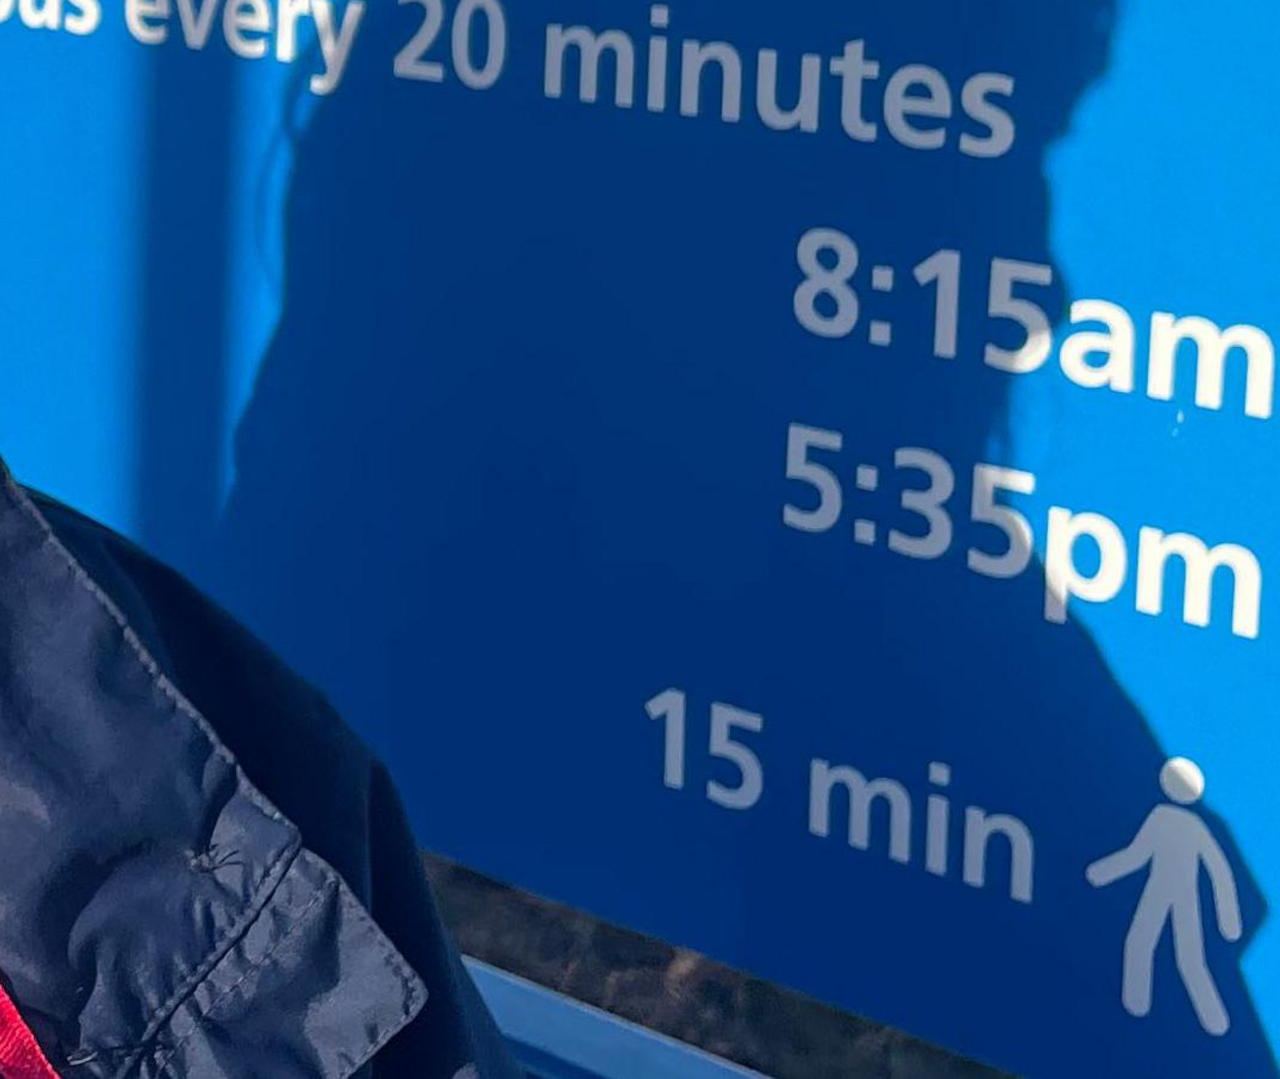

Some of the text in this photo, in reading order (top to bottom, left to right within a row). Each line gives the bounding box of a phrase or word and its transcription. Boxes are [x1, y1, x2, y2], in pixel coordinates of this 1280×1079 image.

[543, 4, 1016, 158] minutes
[793, 227, 1277, 420] 8:15am
[782, 422, 1264, 641] 5:35pm
[645, 688, 1035, 903] 15 min
